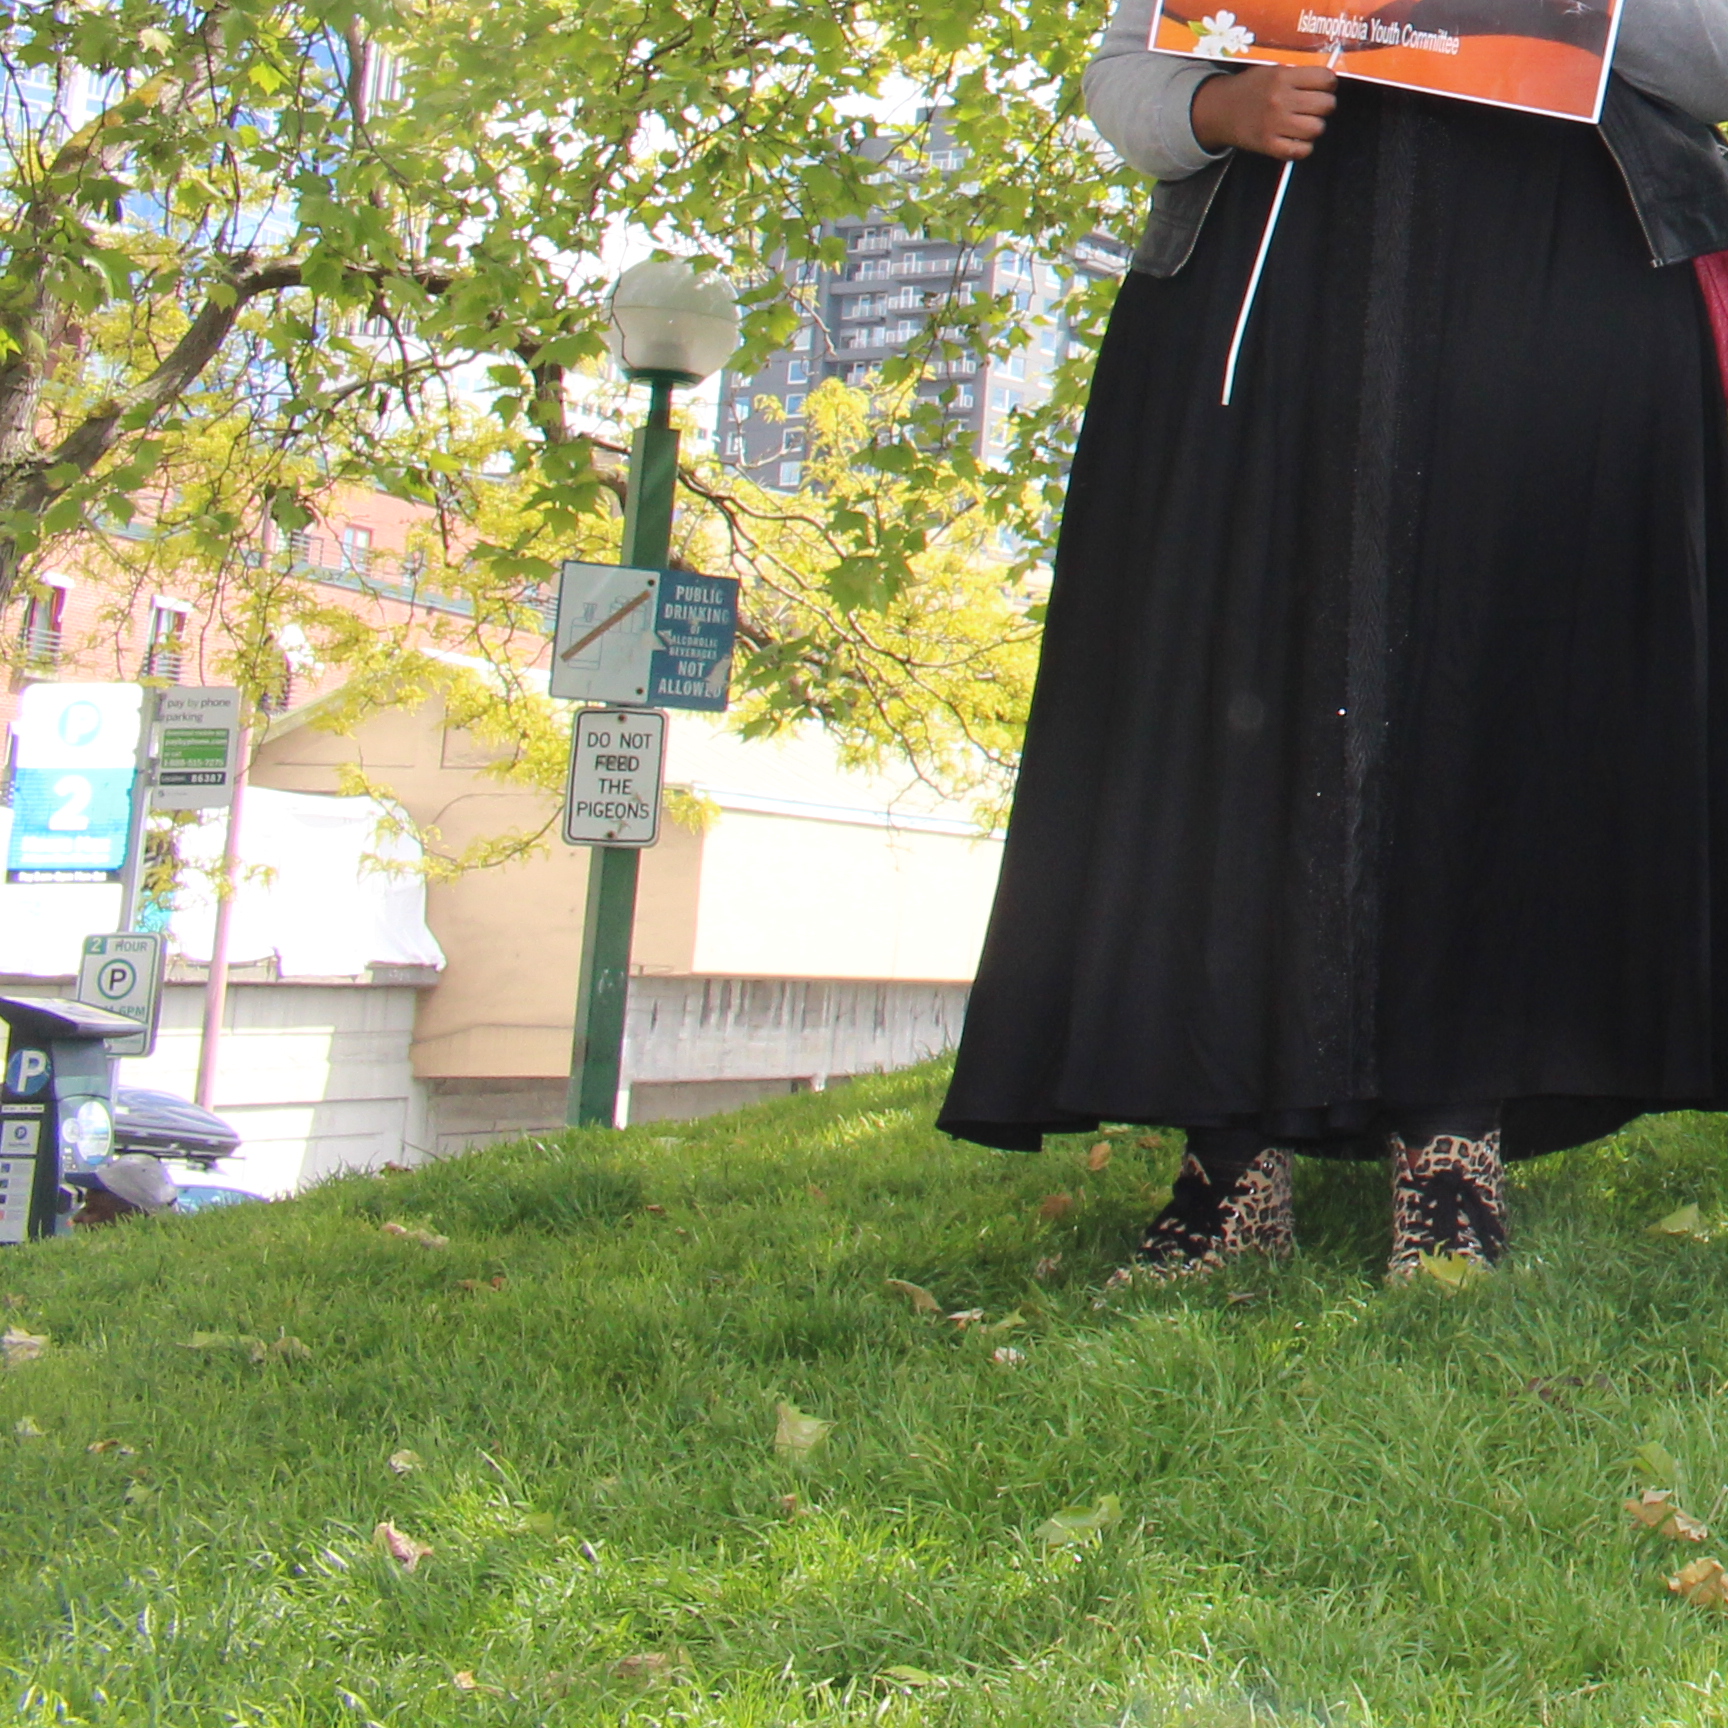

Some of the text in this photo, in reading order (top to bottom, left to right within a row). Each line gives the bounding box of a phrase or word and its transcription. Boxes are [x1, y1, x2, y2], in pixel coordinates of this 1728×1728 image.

[1296, 9, 1460, 55] Islamophobia Youth Committee
[675, 585, 723, 605] PUBLIC
[664, 603, 730, 625] DRINKING
[677, 660, 706, 678] NOT
[167, 697, 231, 709] pay by phone
[165, 713, 204, 723] parking
[587, 731, 653, 750] DO NOT
[595, 755, 640, 772] FEED
[190, 773, 223, 783] 86387
[599, 778, 633, 795] THE
[48, 775, 92, 831] 2
[576, 801, 650, 820] PIGEONS
[90, 936, 148, 953] 2 HOUR
[108, 968, 128, 992] P
[17, 1050, 48, 1093] P
